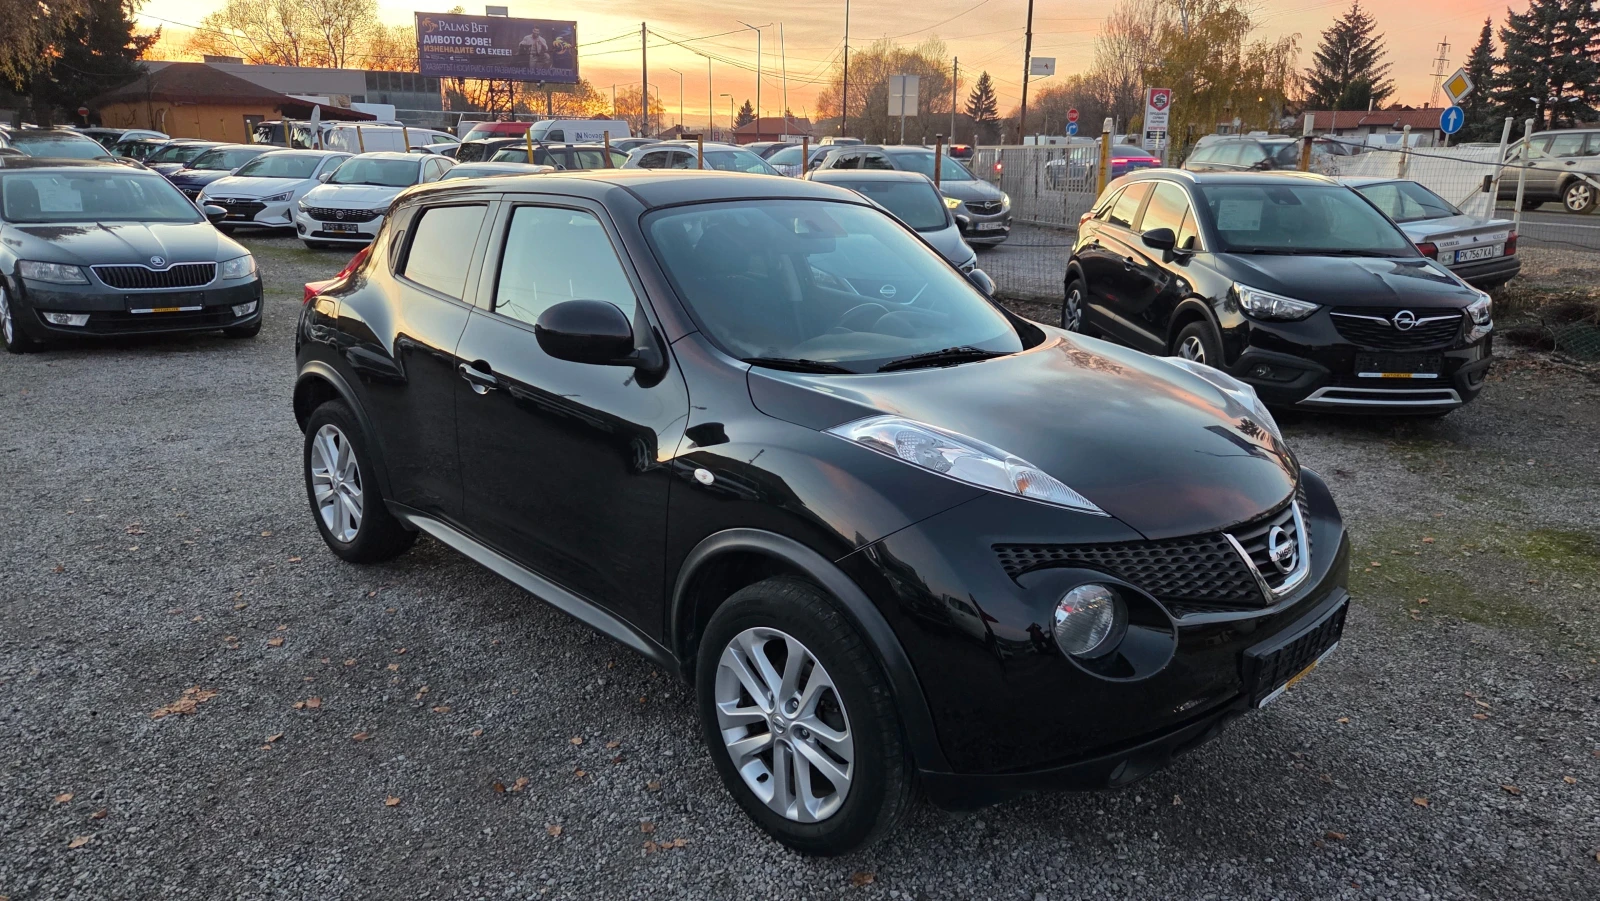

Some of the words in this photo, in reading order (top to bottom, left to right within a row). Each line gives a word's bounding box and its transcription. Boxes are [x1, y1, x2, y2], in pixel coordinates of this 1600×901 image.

[438, 20, 470, 32] PALMS
[471, 22, 489, 33] BET
[423, 34, 463, 45] ДИВОТО
[465, 37, 492, 47] ЗОВЕ!
[423, 45, 475, 54] ИЗНЕНАДИТЕ
[1460, 251, 1468, 260] PK
[1468, 247, 1484, 260] 7567
[1484, 246, 1492, 256] KA
